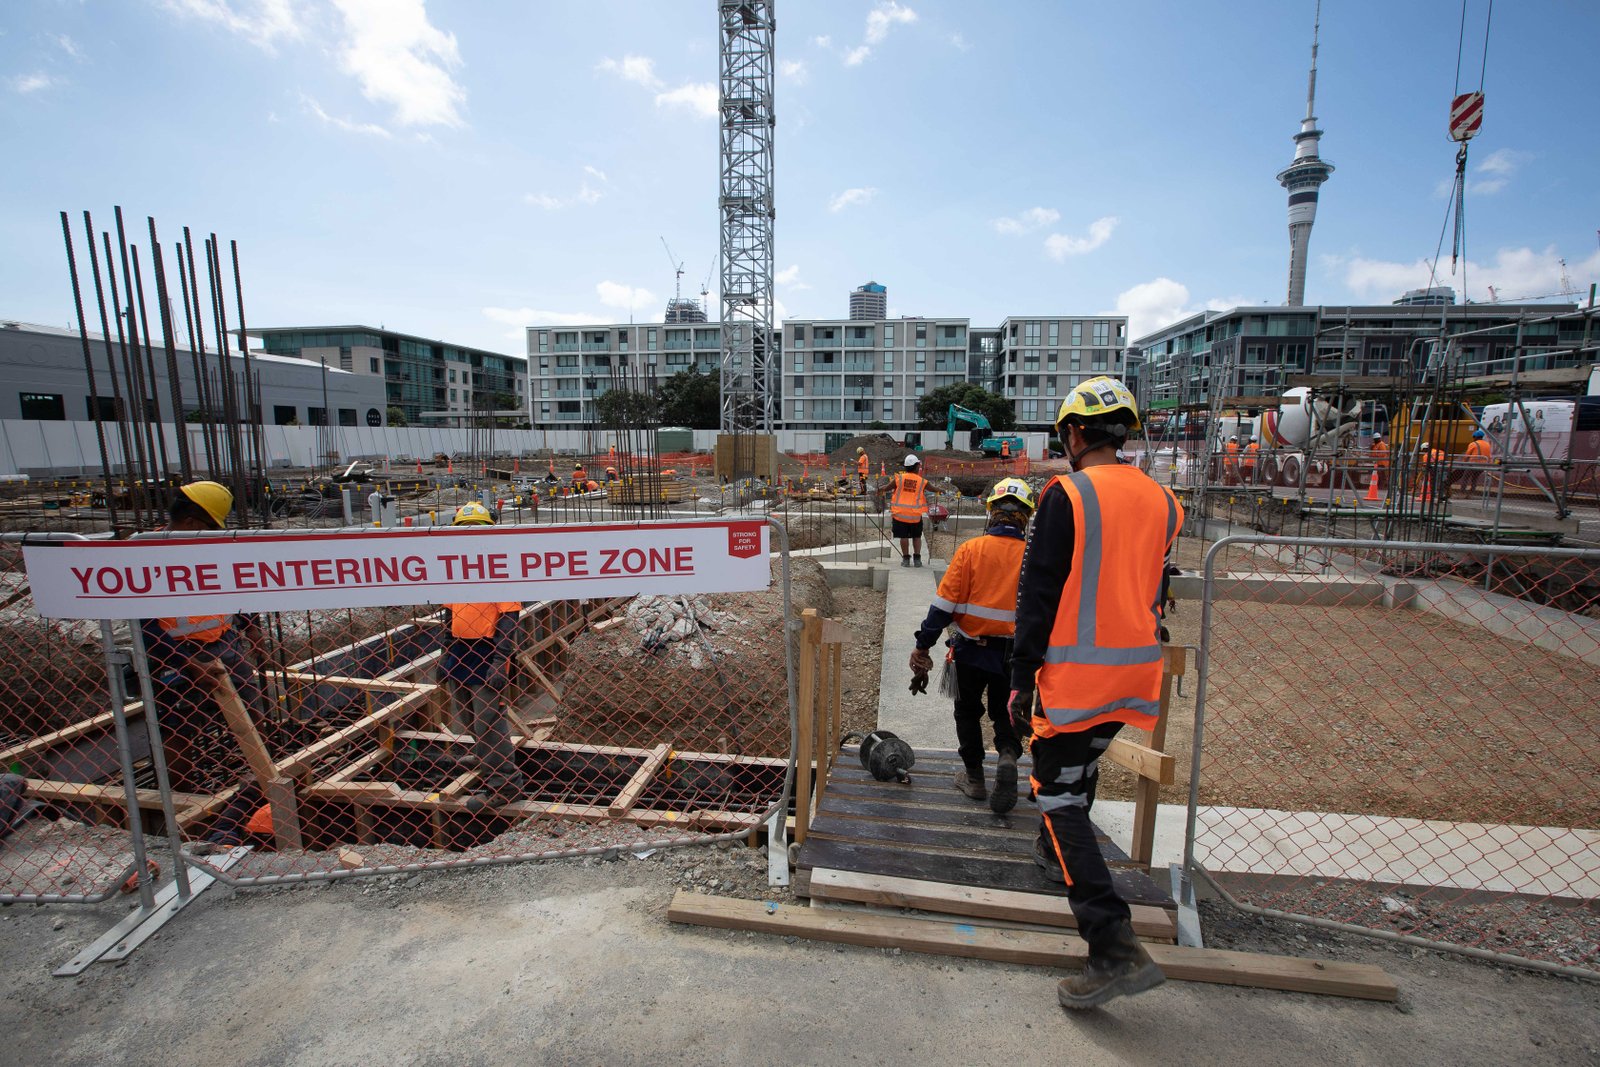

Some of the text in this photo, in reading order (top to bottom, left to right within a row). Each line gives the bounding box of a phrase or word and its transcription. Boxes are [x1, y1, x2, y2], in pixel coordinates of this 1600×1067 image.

[70, 546, 694, 594] YOU'RE ENTERING THE PPE ZONE
